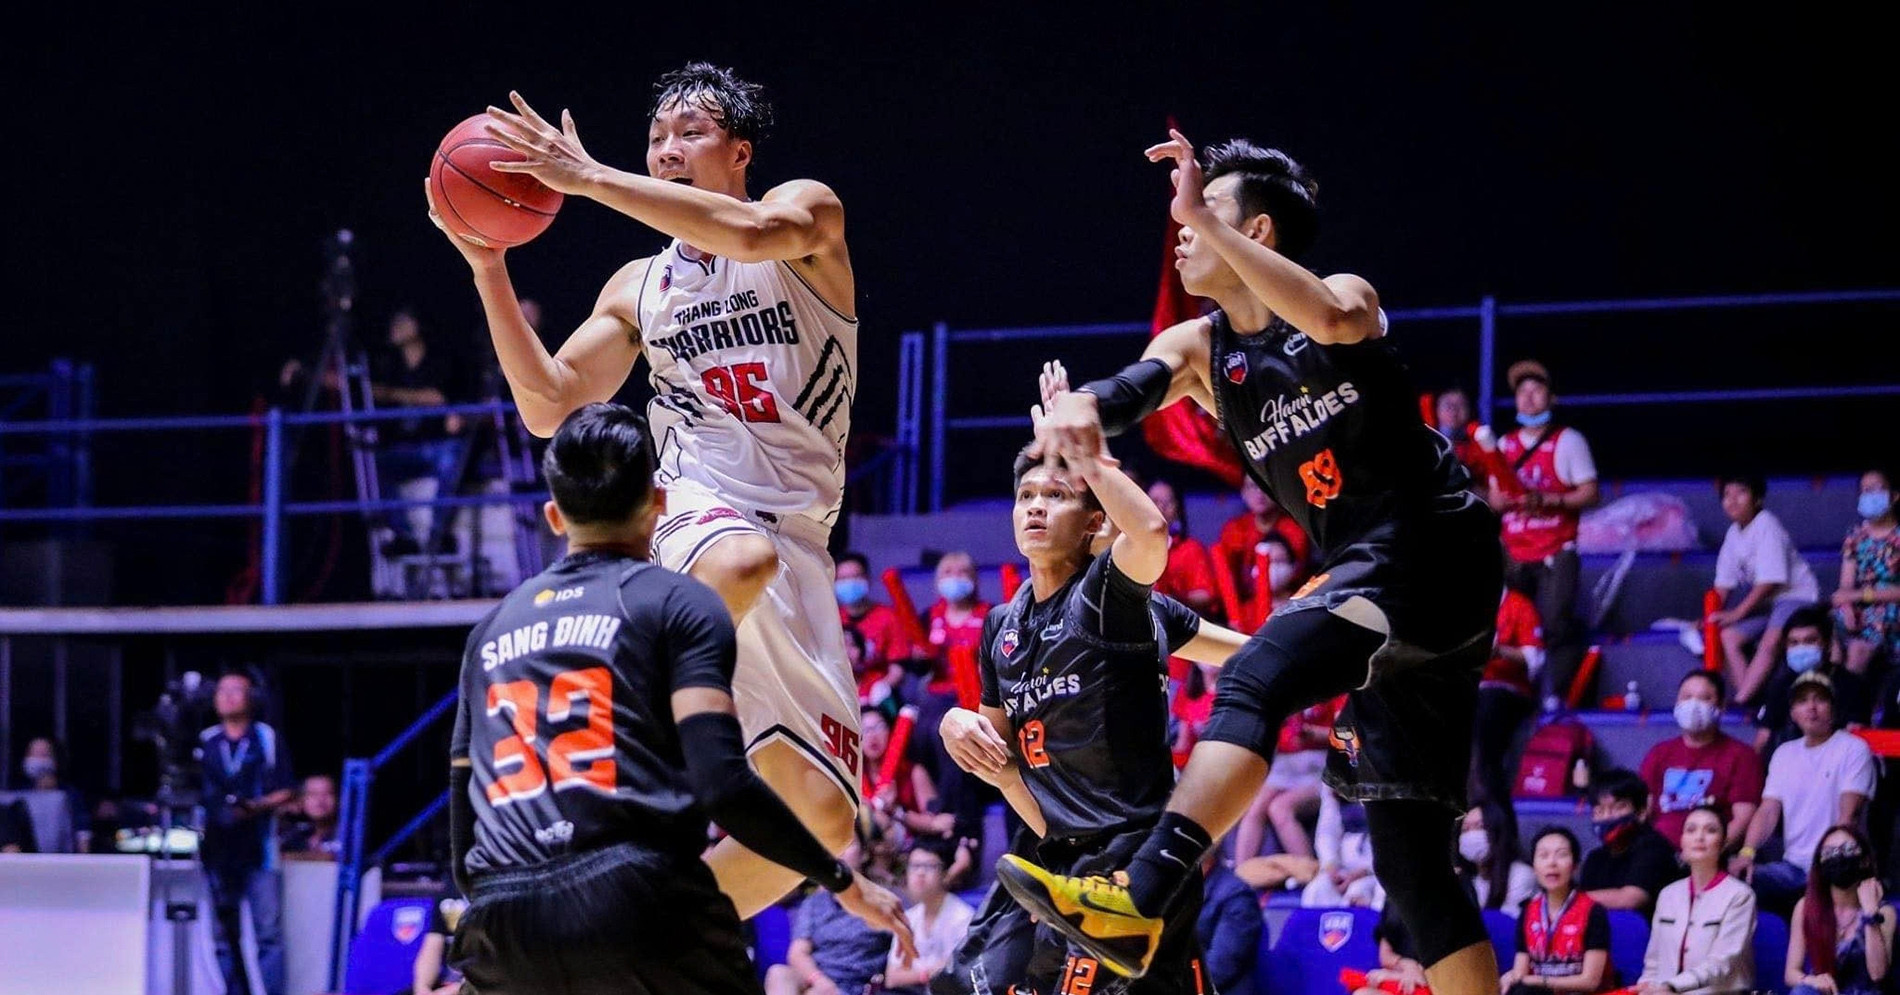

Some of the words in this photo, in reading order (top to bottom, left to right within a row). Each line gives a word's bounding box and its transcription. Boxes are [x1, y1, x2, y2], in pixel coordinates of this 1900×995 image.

[650, 301, 800, 363] WARRIORS
[674, 300, 721, 326] THANG
[725, 289, 759, 313] LONG
[701, 362, 782, 423] 96
[1244, 382, 1359, 460] BUFFALOES
[555, 586, 585, 601] IDS
[481, 621, 549, 672] SANG
[486, 667, 617, 806] 32
[821, 713, 860, 777] 96
[1061, 956, 1099, 995] 12
